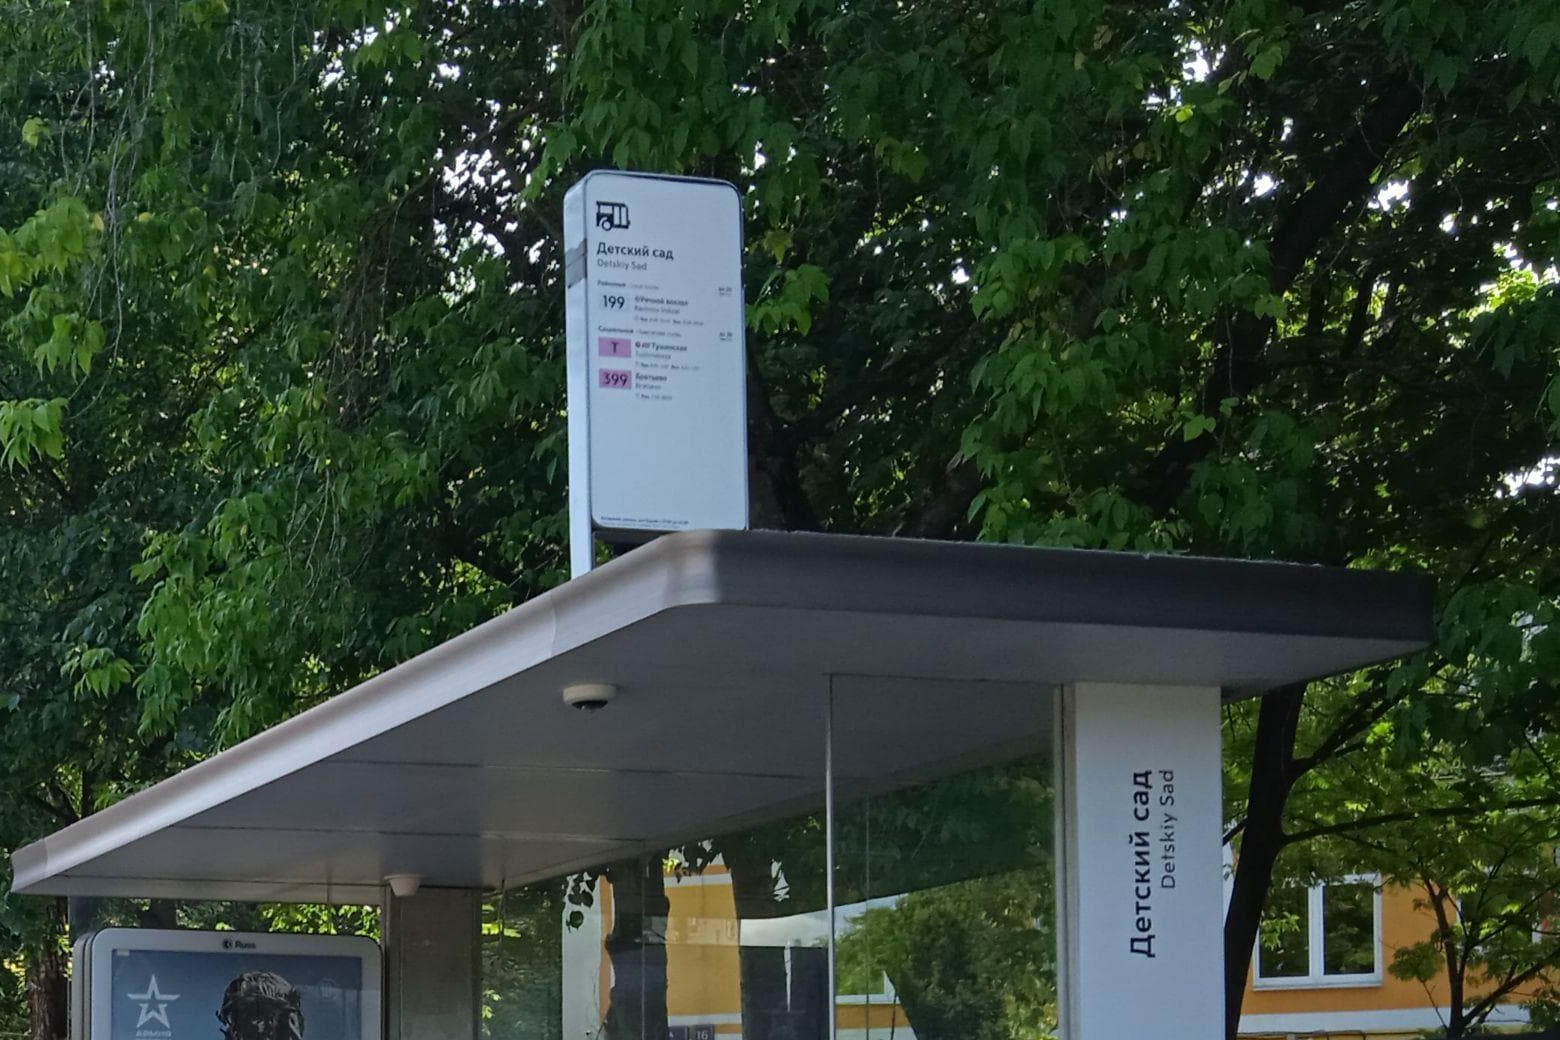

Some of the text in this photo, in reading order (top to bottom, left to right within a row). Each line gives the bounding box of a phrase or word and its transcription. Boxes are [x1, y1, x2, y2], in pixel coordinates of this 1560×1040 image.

[597, 241, 675, 260] Детский сад
[603, 294, 626, 309] 199
[603, 371, 628, 387] 399
[1159, 769, 1178, 889] Detskiy Sad
[1129, 769, 1156, 958] Детский сад
[696, 1030, 709, 1040] 16
